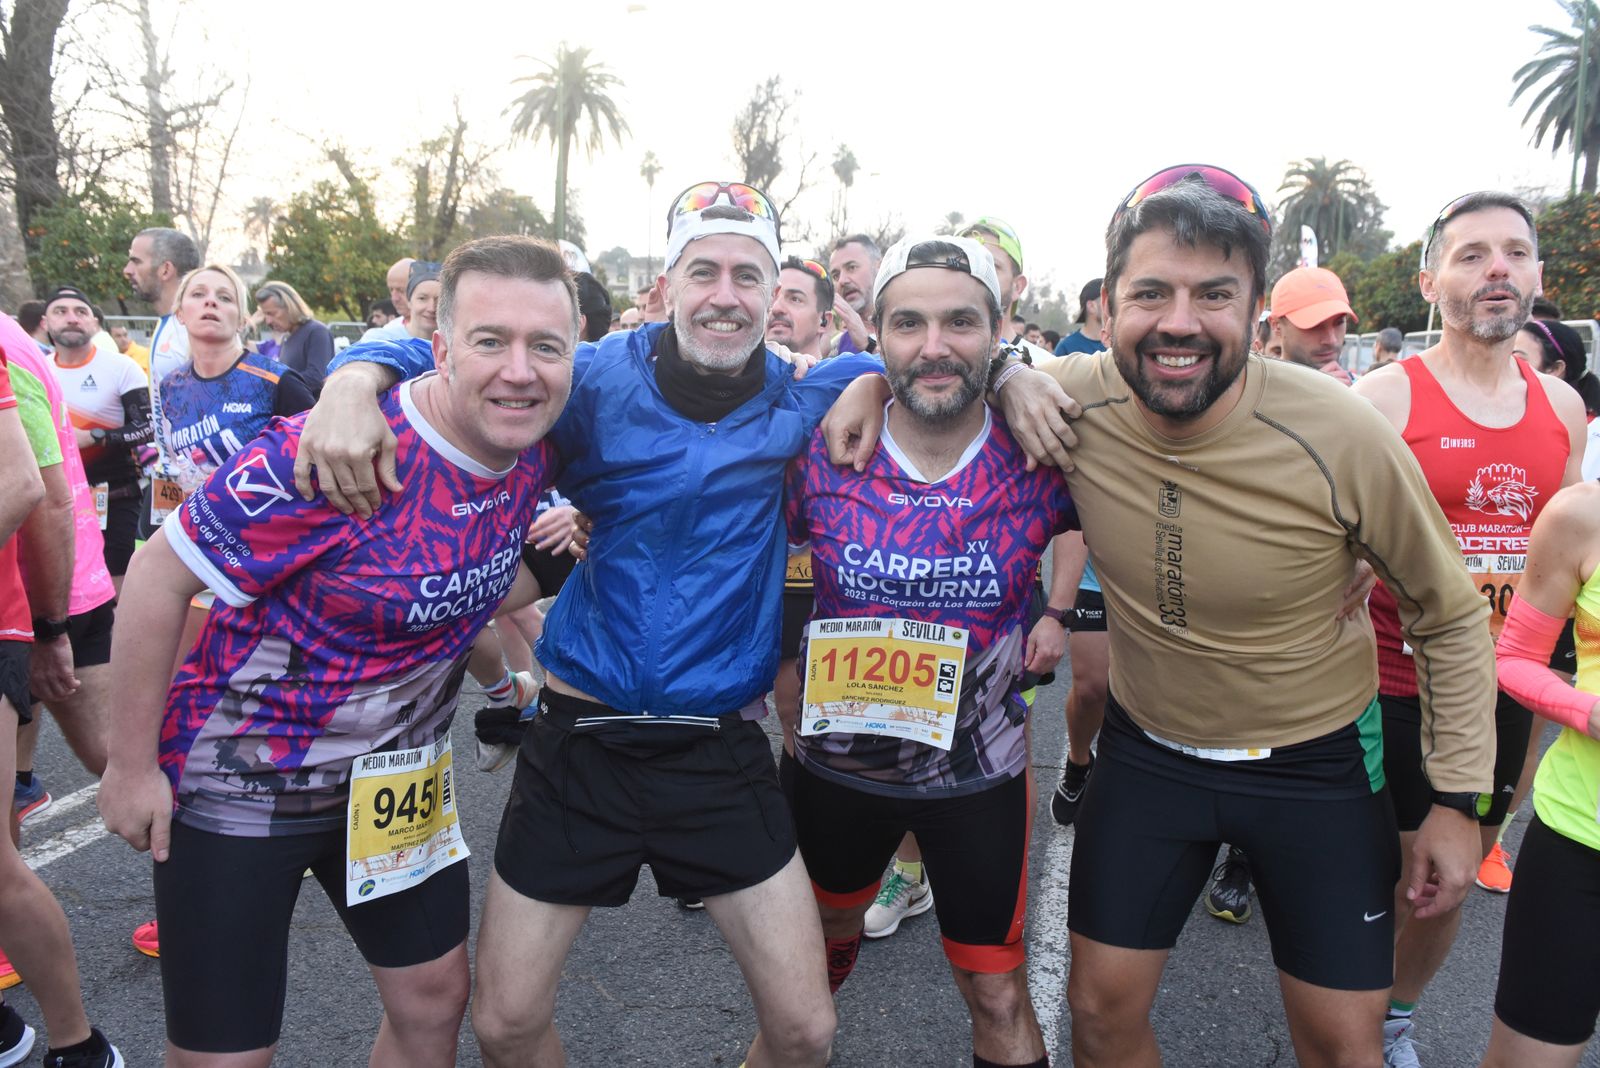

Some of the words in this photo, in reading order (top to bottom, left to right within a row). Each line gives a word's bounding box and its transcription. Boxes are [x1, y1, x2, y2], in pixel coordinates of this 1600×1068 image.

[222, 402, 252, 414] HOKA
[451, 490, 511, 517] GIVOVA
[887, 493, 973, 509] GIVOVA
[196, 480, 237, 544] yuntamiento
[236, 543, 251, 557] de
[1155, 521, 1183, 534] media
[1450, 523, 1477, 533] CLUB
[187, 498, 201, 524] Viso
[199, 524, 218, 543] del
[214, 542, 242, 568] Alcor
[508, 525, 522, 544] XV
[966, 540, 989, 555] XV
[420, 540, 522, 599] CARRERA
[843, 543, 998, 581] CARRERA
[1167, 532, 1187, 606] maratón
[1464, 555, 1483, 568] ATÓN
[837, 565, 1001, 598] NOCTURNA
[844, 588, 867, 601] 2023
[869, 594, 879, 602] El
[881, 596, 925, 609] Corazón
[928, 600, 942, 609] de
[944, 600, 963, 609] Los
[965, 600, 1003, 609] Alcores
[1158, 603, 1187, 628] 33
[819, 621, 843, 634] MEDIO
[845, 619, 882, 633] MARATÓN
[902, 620, 946, 642] SEVILLA
[821, 646, 937, 688] 11205
[865, 722, 887, 730] HOKA
[361, 754, 386, 771] MEDIO
[388, 747, 422, 768] MARATÓN
[388, 825, 415, 837] MARCO
